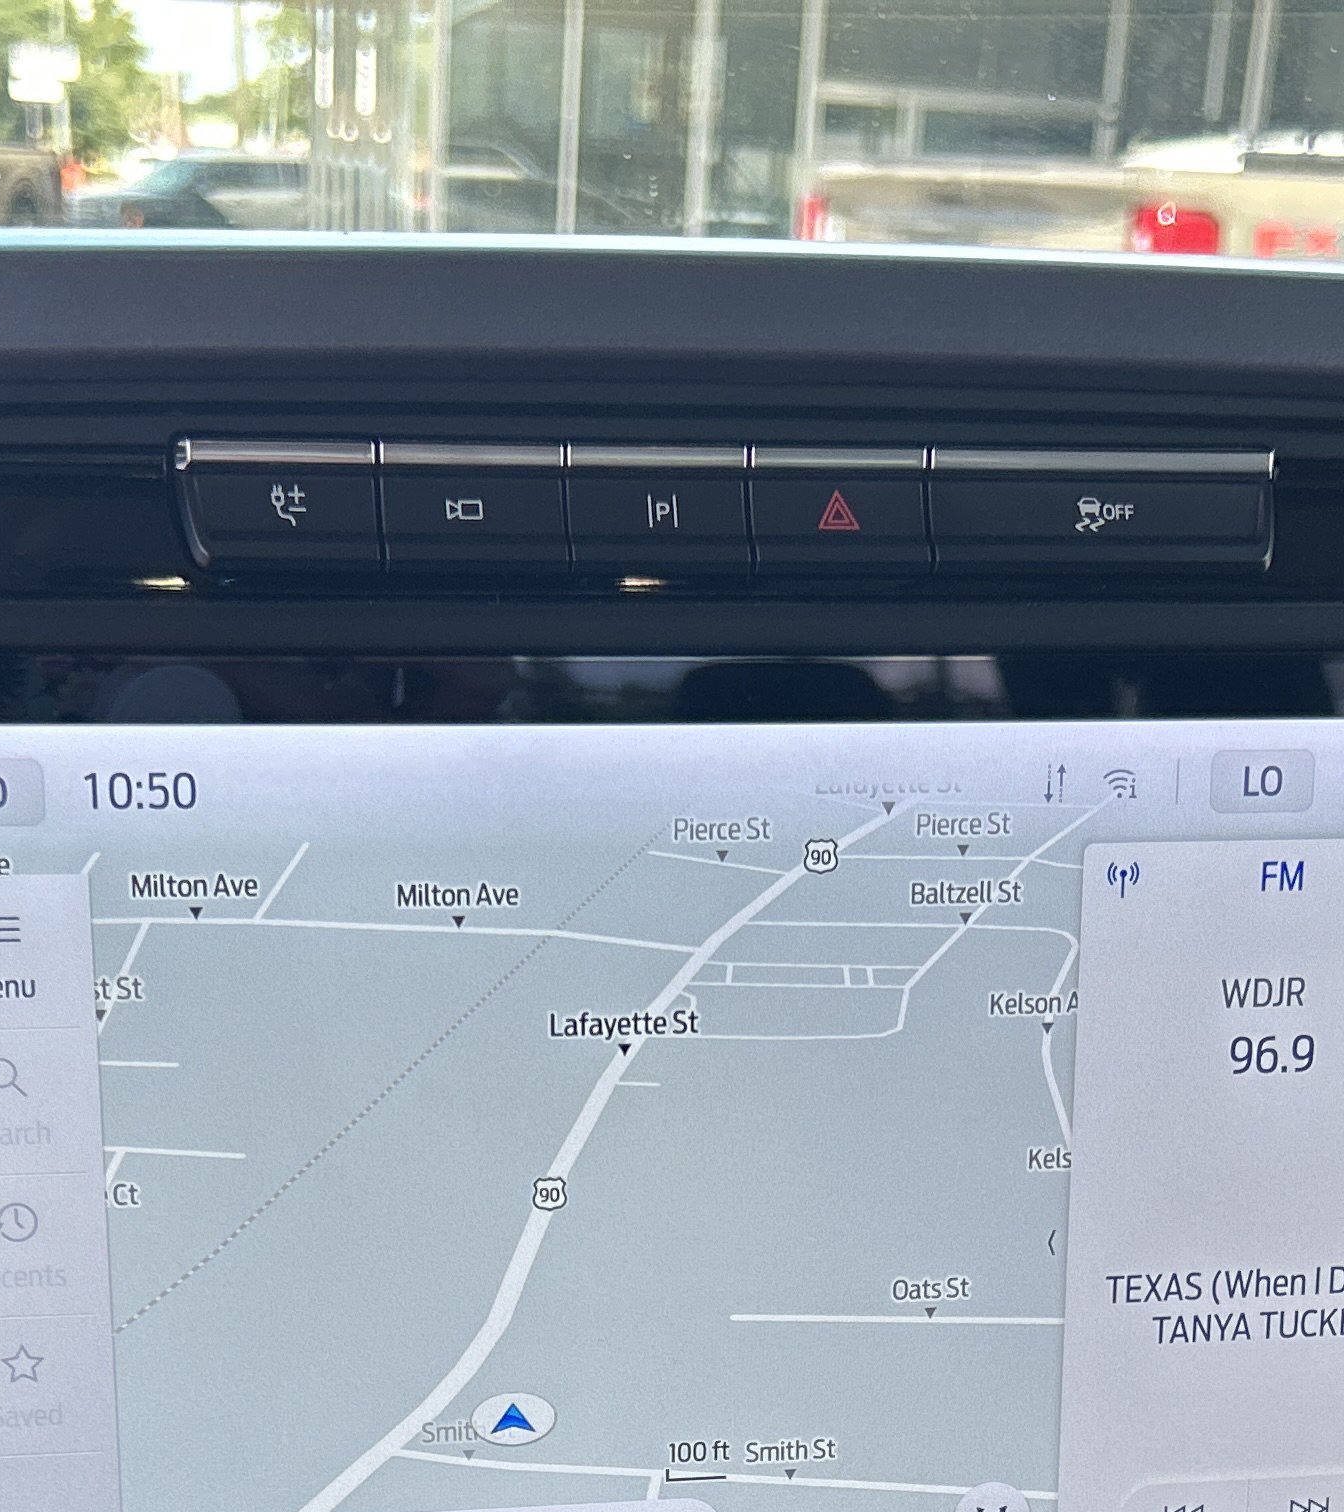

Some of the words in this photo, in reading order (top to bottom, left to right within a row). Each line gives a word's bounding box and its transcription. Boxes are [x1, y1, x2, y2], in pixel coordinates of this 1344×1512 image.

[1102, 504, 1134, 520] OFF
[83, 771, 198, 811] 10:50
[1243, 765, 1284, 798] LO
[674, 818, 741, 841] Pierce
[745, 817, 771, 839] St
[916, 814, 982, 836] Pierce
[987, 812, 1011, 835] St
[811, 849, 832, 866] 90
[131, 874, 208, 899] Milton
[213, 874, 258, 898] Ave
[1261, 862, 1306, 893] FM
[396, 882, 470, 907] Milton
[475, 883, 519, 906] Ave
[911, 881, 991, 904] Baltzell
[998, 881, 1021, 902] St
[116, 977, 143, 1000] St
[1221, 977, 1307, 1010] WDJR
[990, 992, 1061, 1015] Kelson
[550, 1012, 667, 1041] Lafayette
[673, 1010, 699, 1034] St
[1229, 1035, 1316, 1075] 96.9
[113, 1183, 139, 1206] Ct
[539, 1187, 560, 1202] 90
[892, 1279, 940, 1301] Oats
[944, 1277, 970, 1299] St
[1106, 1272, 1202, 1304] TEXAS
[1212, 1269, 1306, 1305] (When
[1315, 1267, 1321, 1294] I
[1152, 1312, 1251, 1344] TANYA
[669, 1441, 707, 1463] 100
[712, 1440, 730, 1460] ft
[746, 1440, 807, 1462] Smith
[813, 1438, 836, 1459] St
